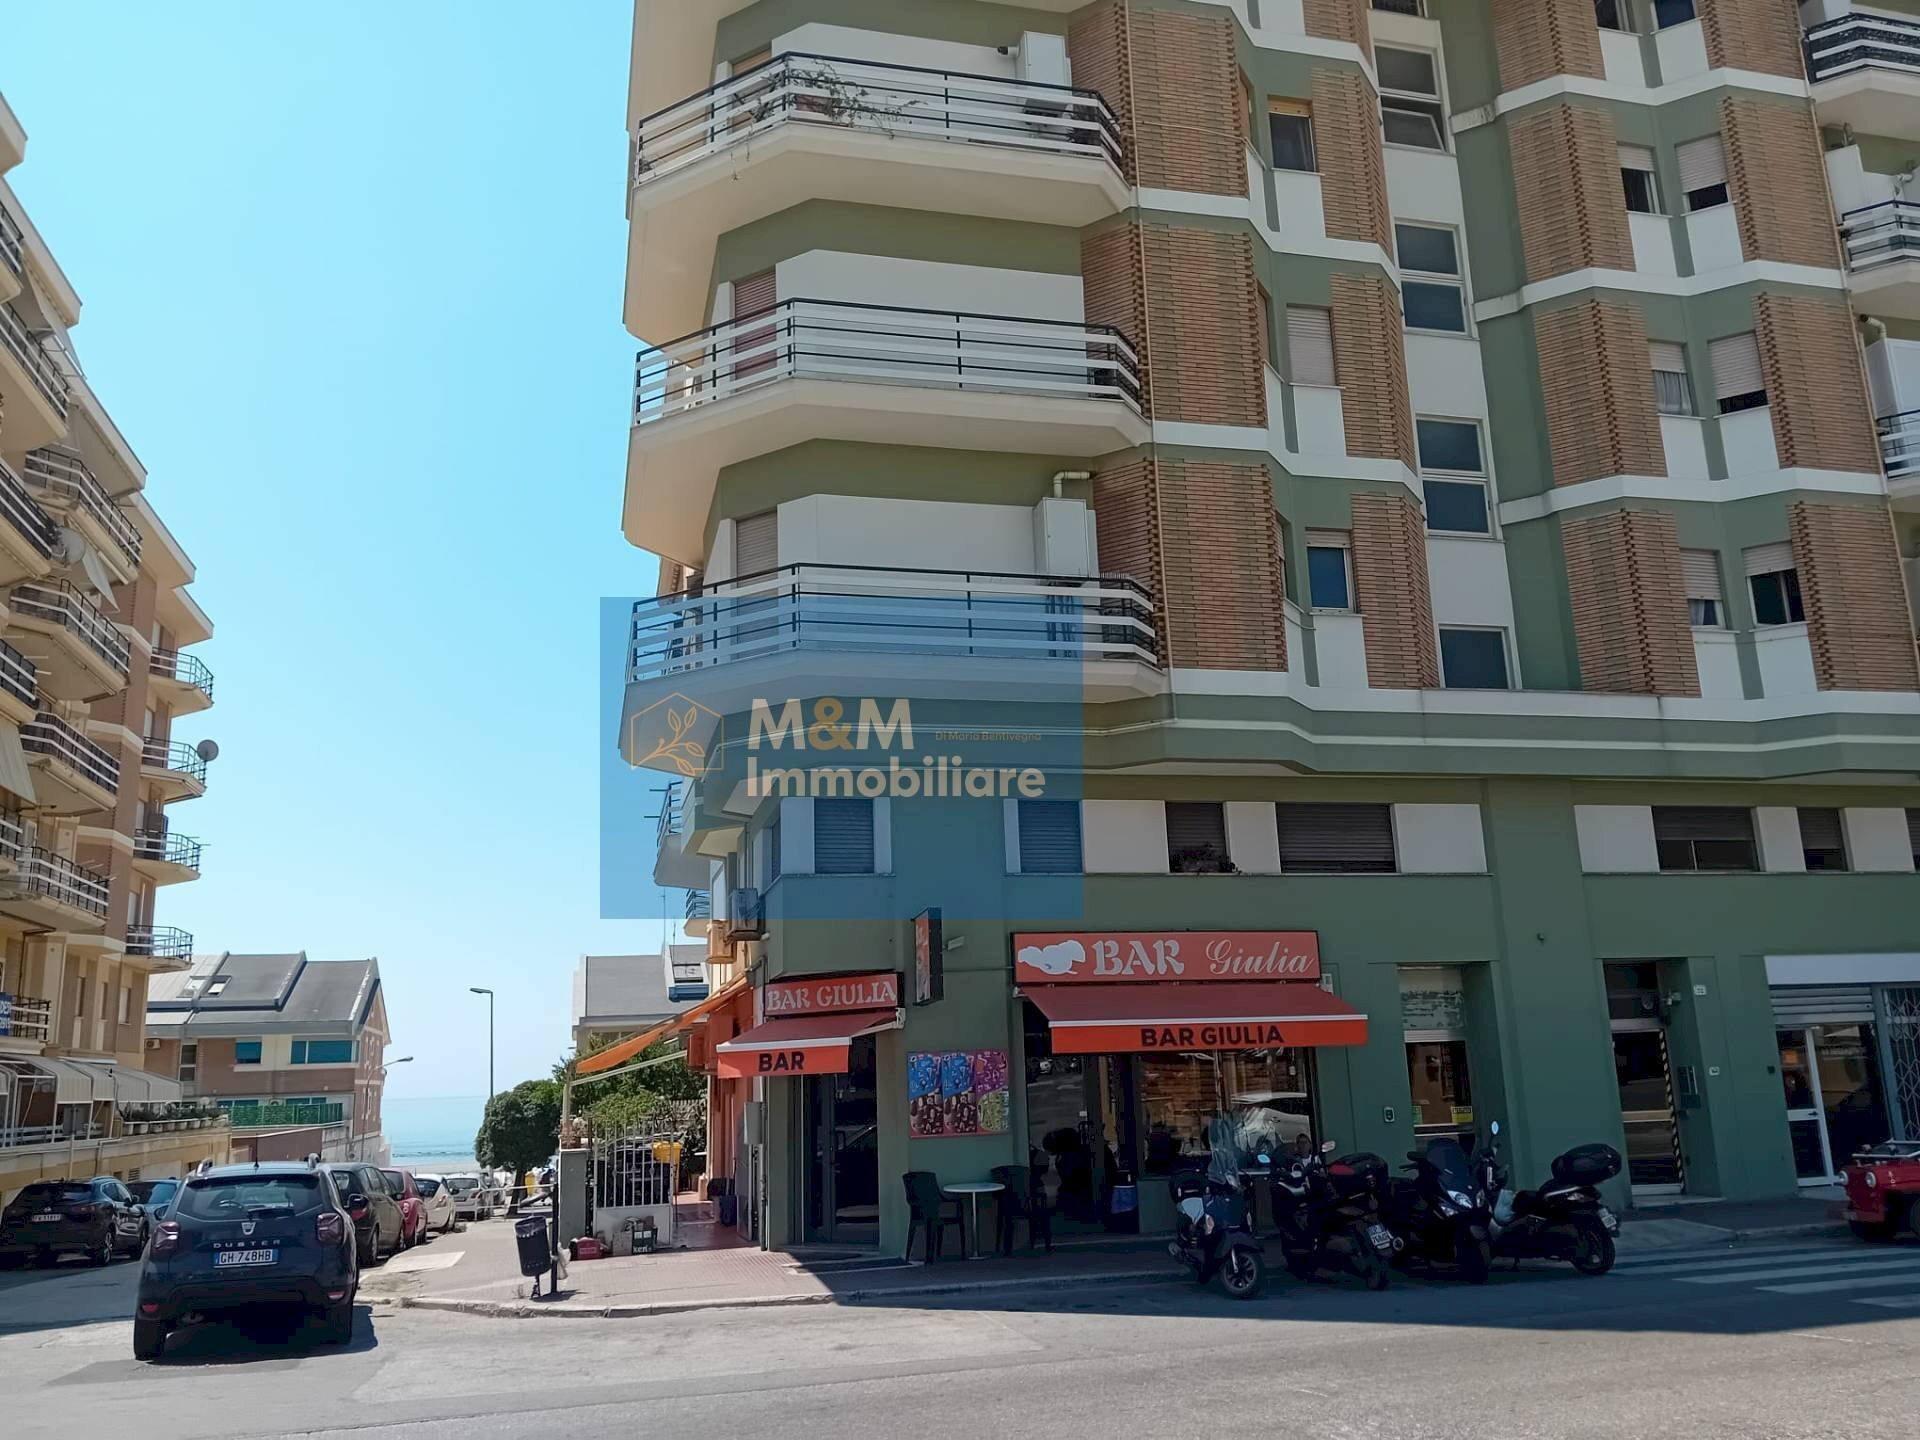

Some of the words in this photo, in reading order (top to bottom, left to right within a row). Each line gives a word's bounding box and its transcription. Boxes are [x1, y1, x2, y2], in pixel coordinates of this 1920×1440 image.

[1091, 939, 1185, 976] BAR
[1206, 938, 1316, 975] Giulia
[766, 987, 811, 1011] BAR
[816, 981, 897, 1007] GIULIA
[1141, 1027, 1194, 1047] BAR
[1200, 1025, 1284, 1045] GIULIA
[758, 1051, 805, 1072] BAR
[213, 1239, 280, 1248] DUSTER
